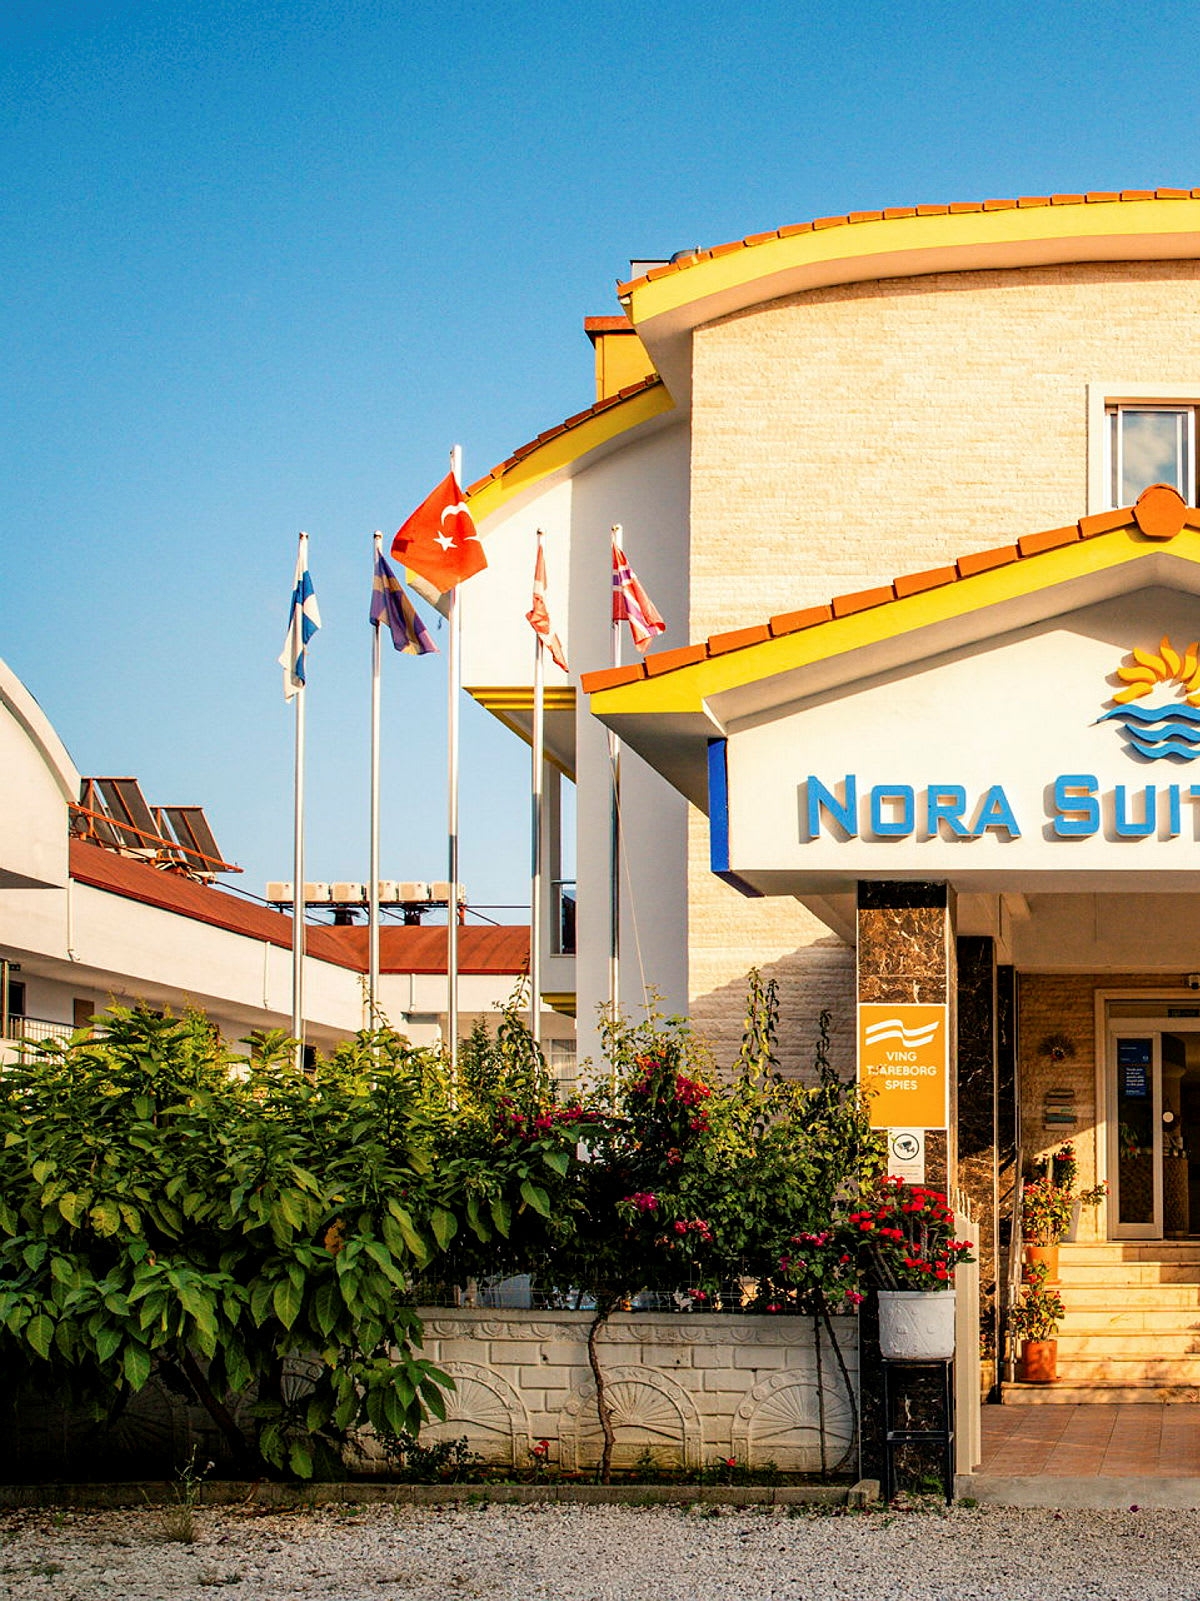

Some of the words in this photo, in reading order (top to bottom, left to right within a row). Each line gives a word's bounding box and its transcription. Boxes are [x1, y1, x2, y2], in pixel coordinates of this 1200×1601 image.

[806, 774, 1021, 838] NORA
[886, 1051, 917, 1062] VING
[885, 1080, 918, 1090] SPIES
